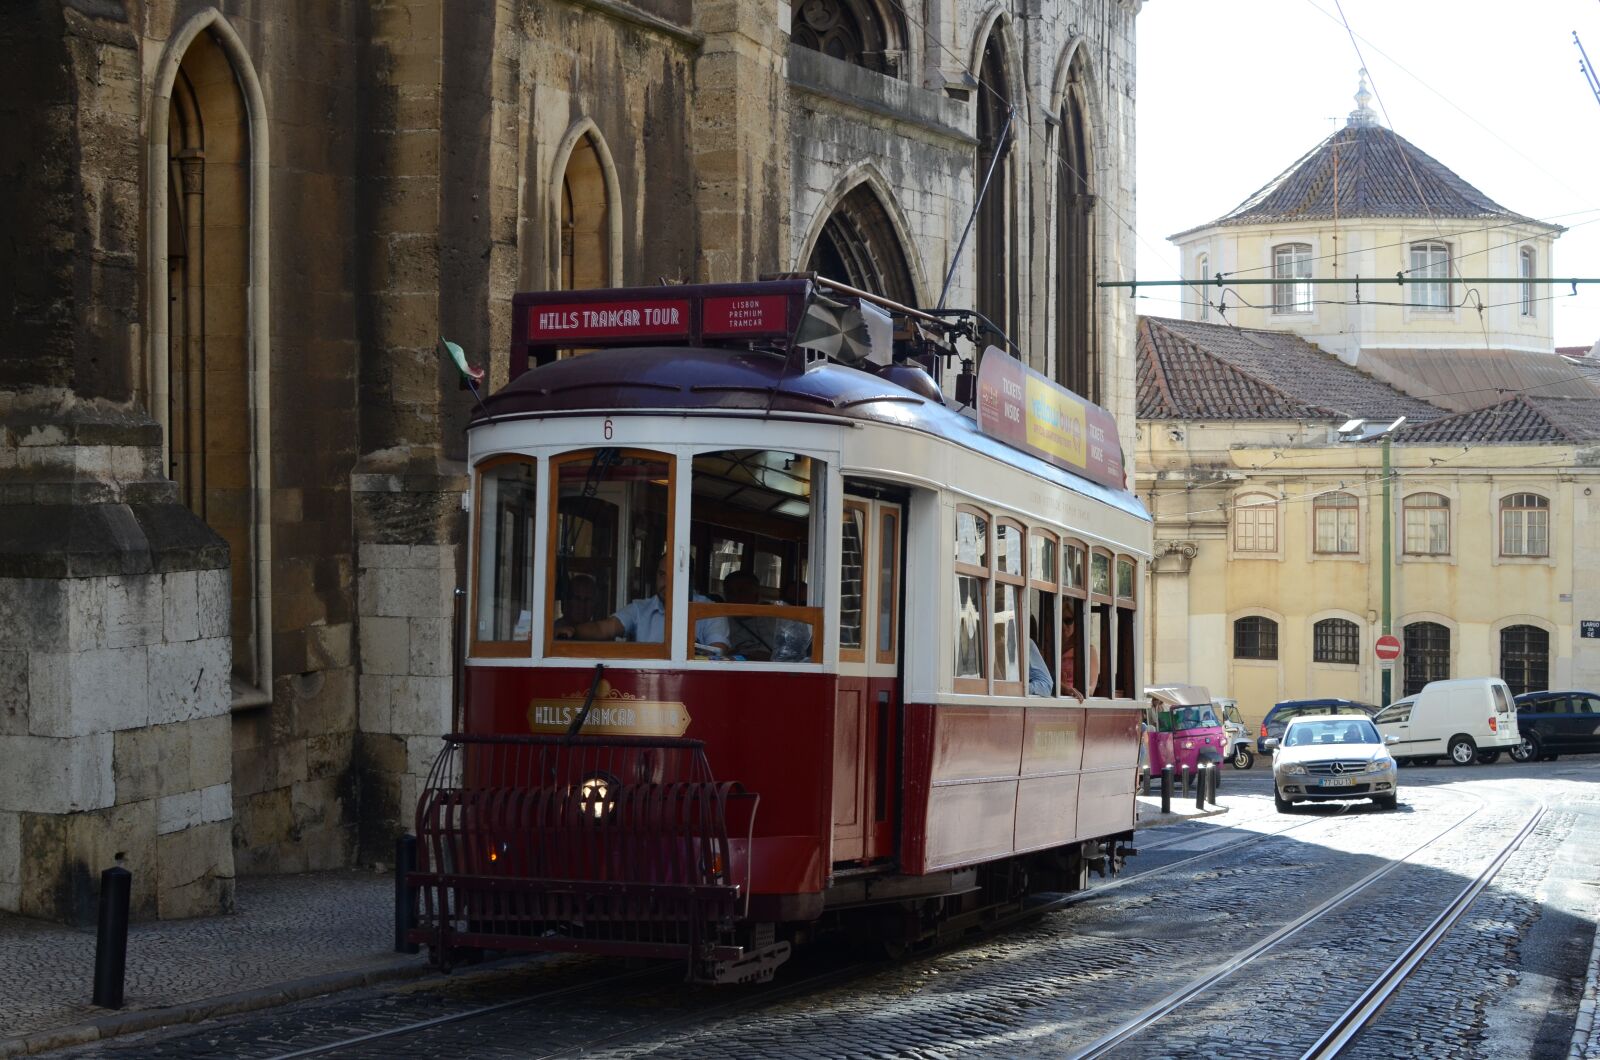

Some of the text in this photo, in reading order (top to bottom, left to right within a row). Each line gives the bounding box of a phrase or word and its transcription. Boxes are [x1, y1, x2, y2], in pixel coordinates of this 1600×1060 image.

[729, 310, 763, 318] PREMIUM
[732, 300, 760, 309] LISBON
[539, 307, 680, 330] HILLS TRAMCAR TOUR
[729, 318, 762, 327] TRAMCAR
[1002, 377, 1022, 401] TICKETS
[1004, 401, 1020, 424] INSIDE
[604, 419, 613, 440] 6
[535, 706, 571, 726] HILLS
